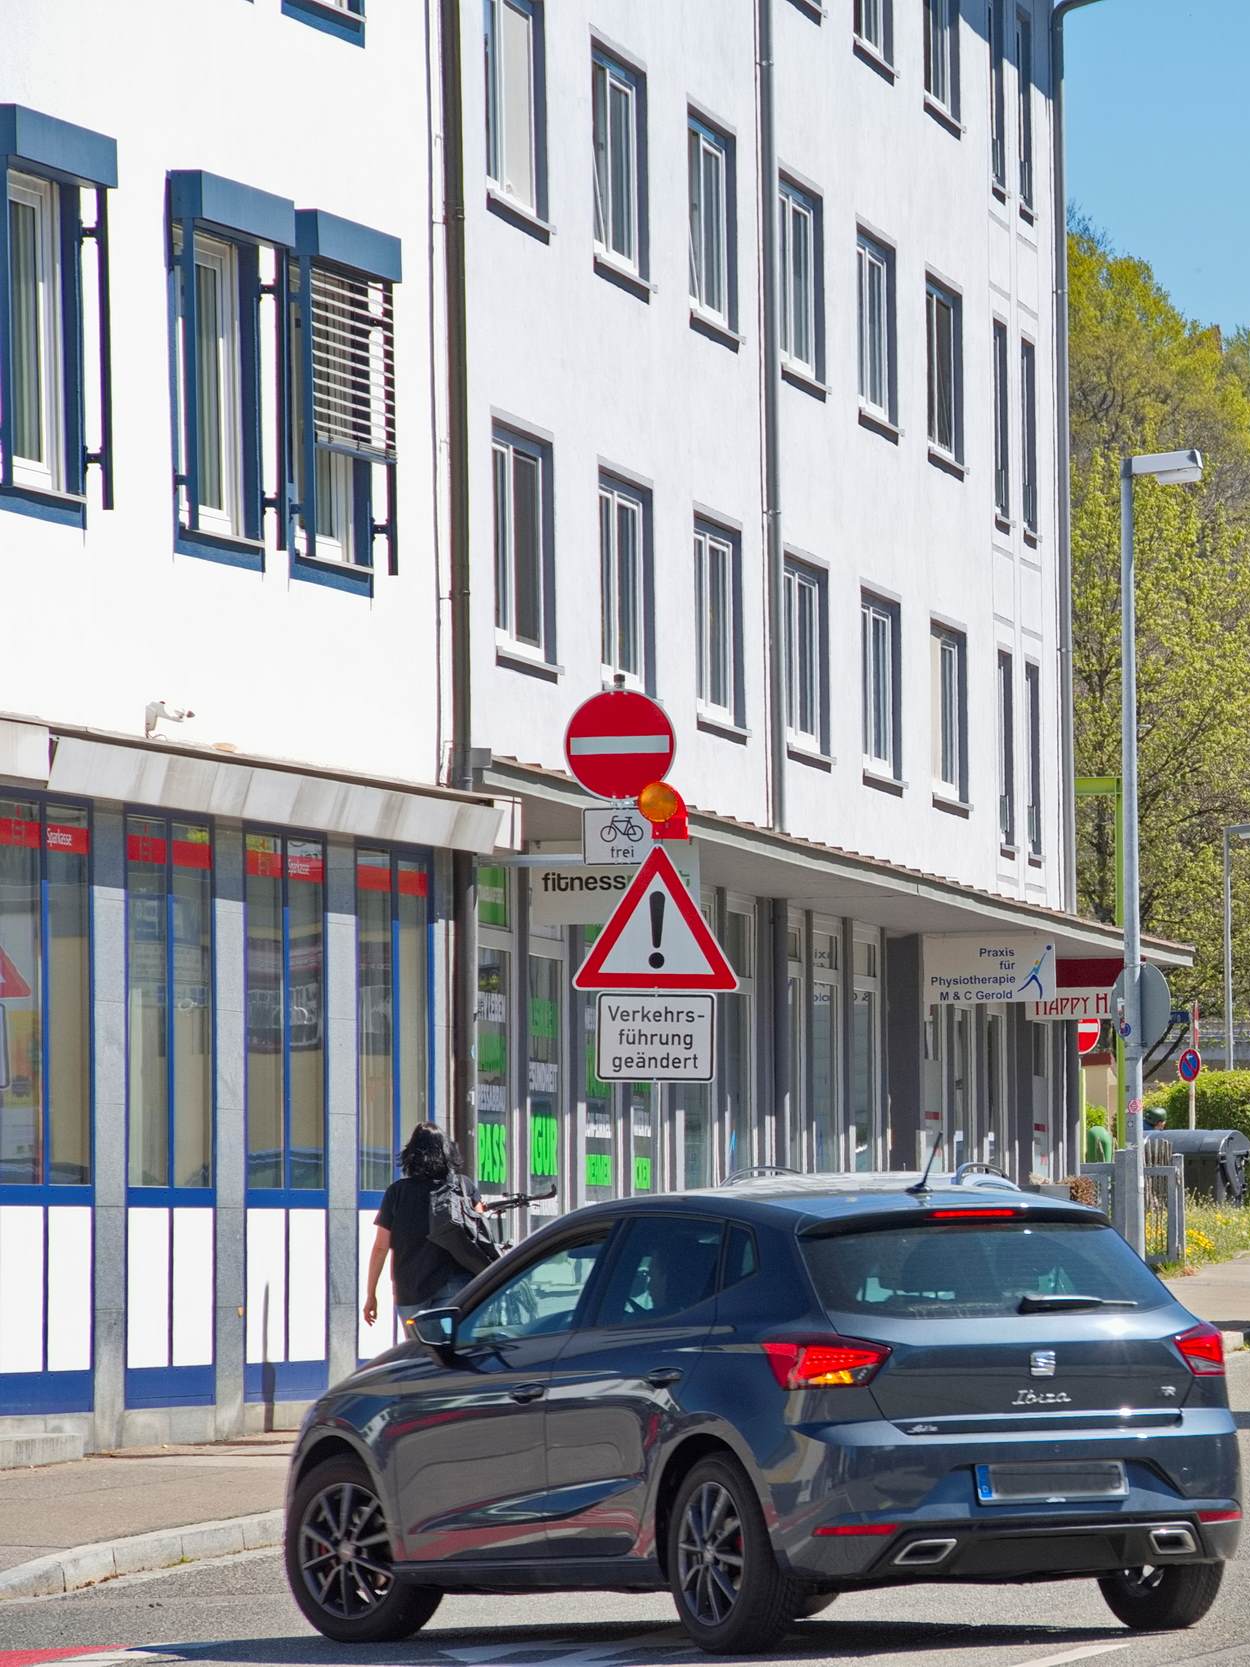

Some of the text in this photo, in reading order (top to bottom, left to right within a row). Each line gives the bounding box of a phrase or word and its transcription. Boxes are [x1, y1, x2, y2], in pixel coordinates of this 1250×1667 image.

[611, 845, 635, 858] frei
[542, 871, 632, 892] fitness
[979, 947, 1015, 958] Praxis
[999, 961, 1016, 970] für
[931, 974, 1016, 988] Physiotherapie
[940, 990, 1013, 1001] M & C Gerold
[1035, 992, 1110, 1016] HAPPY H
[608, 1005, 705, 1023] Verkehrs-
[618, 1028, 693, 1050] führung
[612, 1051, 699, 1073] geändert
[478, 1122, 507, 1184] PASS
[530, 1116, 558, 1176] IGUR
[1011, 1389, 1072, 1405] Ibiza
